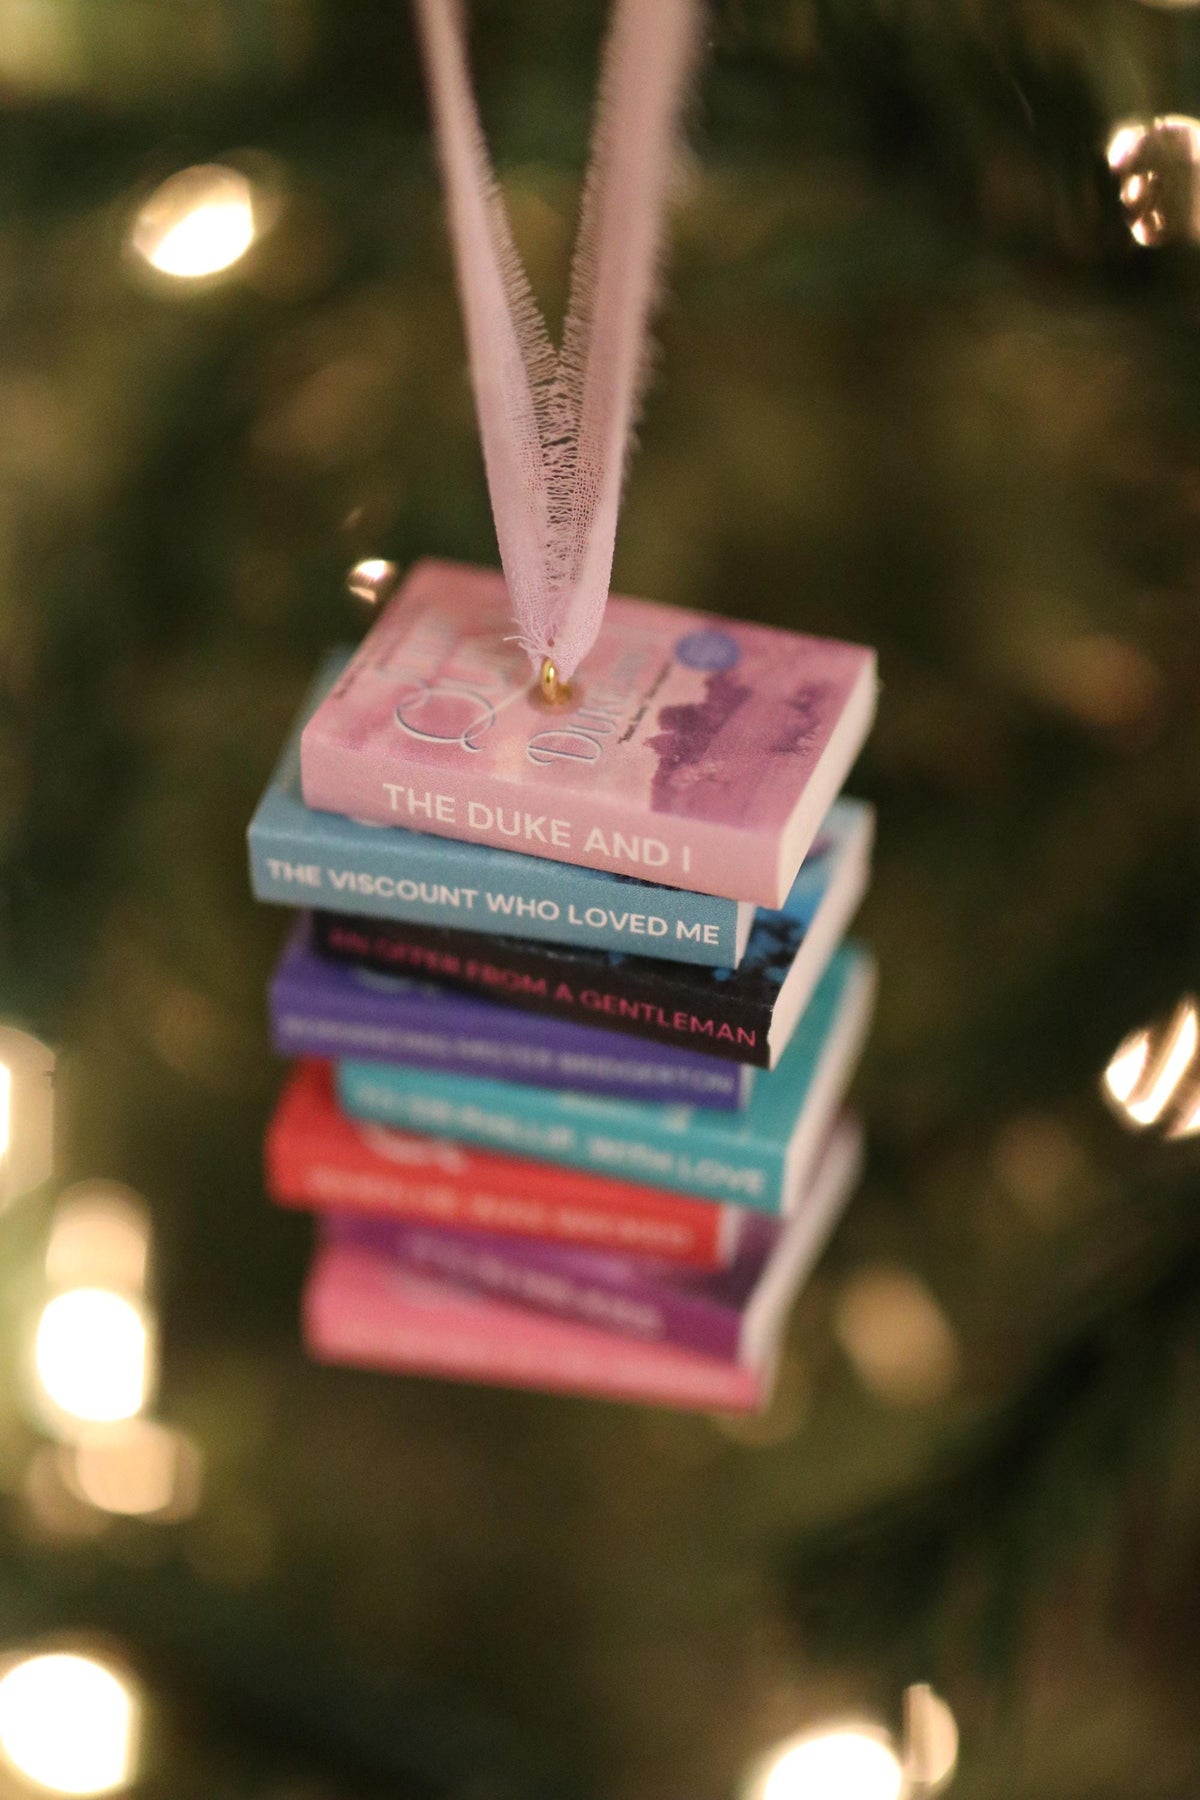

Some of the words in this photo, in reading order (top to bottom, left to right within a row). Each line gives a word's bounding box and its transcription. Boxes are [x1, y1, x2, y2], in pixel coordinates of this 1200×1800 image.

[382, 783, 456, 824] THE
[467, 801, 571, 848] DUKE
[583, 828, 669, 867] AND
[682, 845, 691, 873] I
[267, 859, 322, 886] THE
[327, 868, 478, 908] VISCOUNT
[485, 891, 559, 920] WHO
[568, 904, 669, 936] LOVED
[676, 920, 720, 945] ME
[465, 960, 547, 997] FROM
[553, 982, 574, 1003] A
[580, 989, 756, 1047] GENTLEMAN
